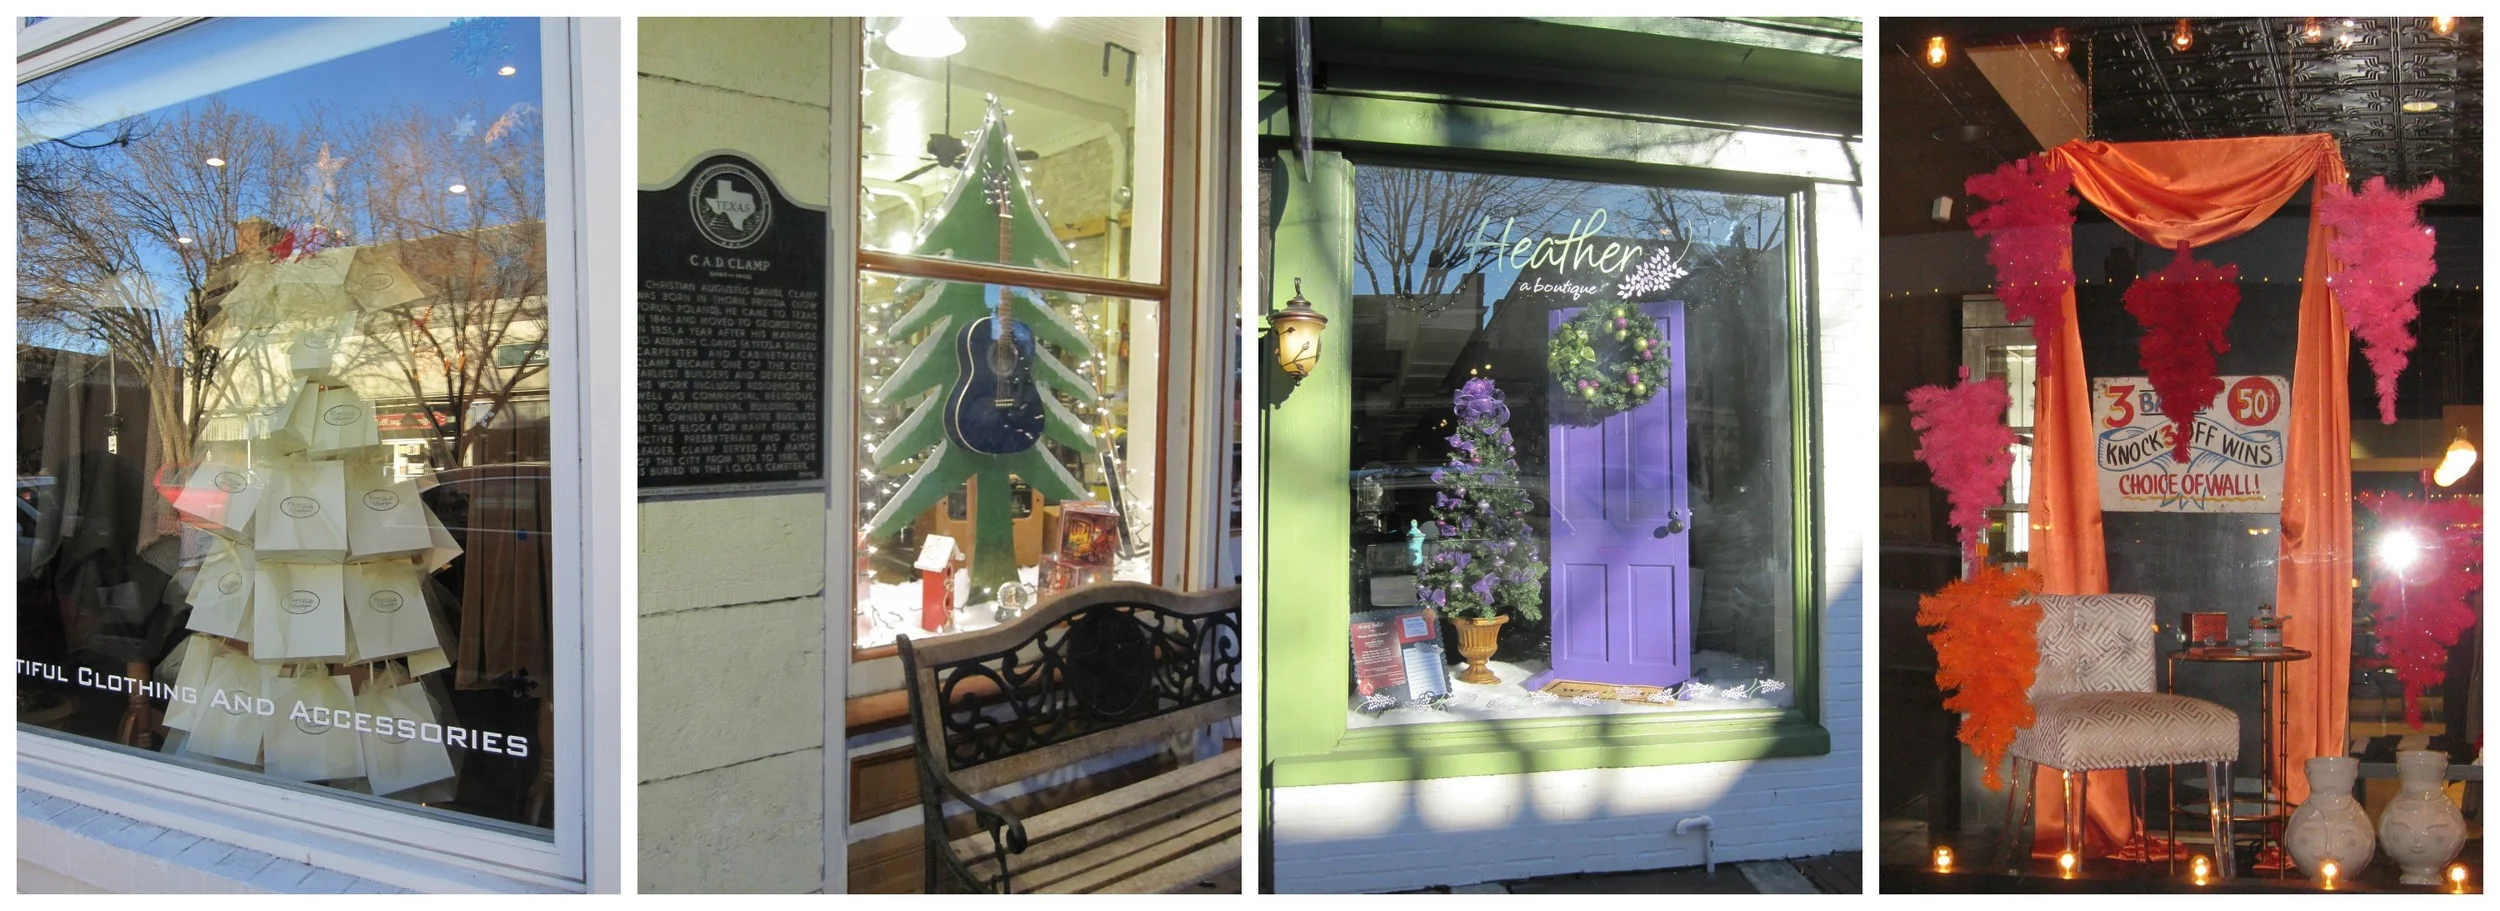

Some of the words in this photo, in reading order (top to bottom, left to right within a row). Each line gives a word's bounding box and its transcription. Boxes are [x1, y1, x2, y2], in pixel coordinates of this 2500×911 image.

[716, 200, 751, 212] TEXAS
[1464, 207, 1643, 275] Heather
[728, 258, 771, 271] CLAMP
[645, 280, 695, 291] CHRISTIAN
[700, 284, 749, 294] AUGUSTUS
[788, 290, 817, 299] CLAMP
[1519, 281, 1532, 292] a
[1533, 277, 1598, 300] boutique
[662, 292, 691, 302] BORN
[696, 294, 707, 303] IN
[725, 307, 737, 316] HE
[742, 307, 768, 318] CAME
[773, 310, 786, 318] TO
[792, 310, 817, 320] TEXAS
[650, 314, 672, 324] 1846
[676, 316, 696, 325] AND
[700, 317, 734, 326] MOVED
[738, 318, 751, 327] TO
[756, 319, 817, 330] GEORGETOWN
[677, 327, 684, 335] A
[689, 327, 713, 337] YEAR
[717, 328, 746, 337] AFTER
[751, 330, 766, 338] HIS
[772, 331, 817, 341] MARRIAGE
[654, 337, 697, 347] ASENATH
[784, 342, 817, 351] SKILLED
[708, 349, 730, 358] AND
[676, 359, 715, 369] BECAME
[721, 360, 742, 369] ONE
[748, 361, 761, 370] OF
[767, 362, 784, 370] THE
[638, 369, 678, 379] ARLIEST
[684, 370, 729, 379] BUILDERS
[735, 371, 755, 380] AND
[657, 381, 689, 391] WORK
[693, 381, 741, 390] INCLUDED
[747, 382, 800, 391] RESIDENCES
[805, 383, 816, 391] AS
[672, 392, 684, 401] AS
[664, 402, 743, 412] GOVERNMENTAL
[804, 402, 816, 411] HE
[2103, 385, 2136, 428] 3
[668, 413, 706, 422] OWNED
[710, 414, 718, 422] A
[723, 412, 771, 422] FURNITURE
[776, 412, 816, 421] BUSINESS
[652, 424, 674, 433] THIS
[680, 424, 712, 432] BLOCK
[718, 422, 736, 432] FOR
[741, 422, 767, 432] MANY
[804, 422, 816, 431] AN
[684, 433, 753, 444] PRESBYTERIAN
[760, 433, 780, 442] AND
[789, 432, 816, 442] CIVIC
[638, 446, 675, 456] EADER,
[681, 445, 716, 455] CLAMP
[722, 444, 758, 454] SERVED
[765, 442, 777, 452] AS
[784, 442, 816, 452] MAYOR
[2106, 430, 2164, 466] KNOCK
[2222, 433, 2273, 466] WINS
[656, 456, 674, 466] THE
[678, 456, 701, 466] CITY
[706, 454, 732, 464] FROM
[761, 453, 774, 462] TO
[804, 452, 816, 461] HE
[650, 466, 686, 476] BURIED
[689, 465, 700, 474] IN
[704, 464, 722, 474] THE
[2119, 473, 2178, 496] CHOICE
[2181, 473, 2205, 496] OF
[2205, 473, 2261, 496] WALL!
[78, 666, 197, 704] CLOTHING
[210, 689, 275, 716] AND
[289, 700, 528, 757] ACCESSORIES
